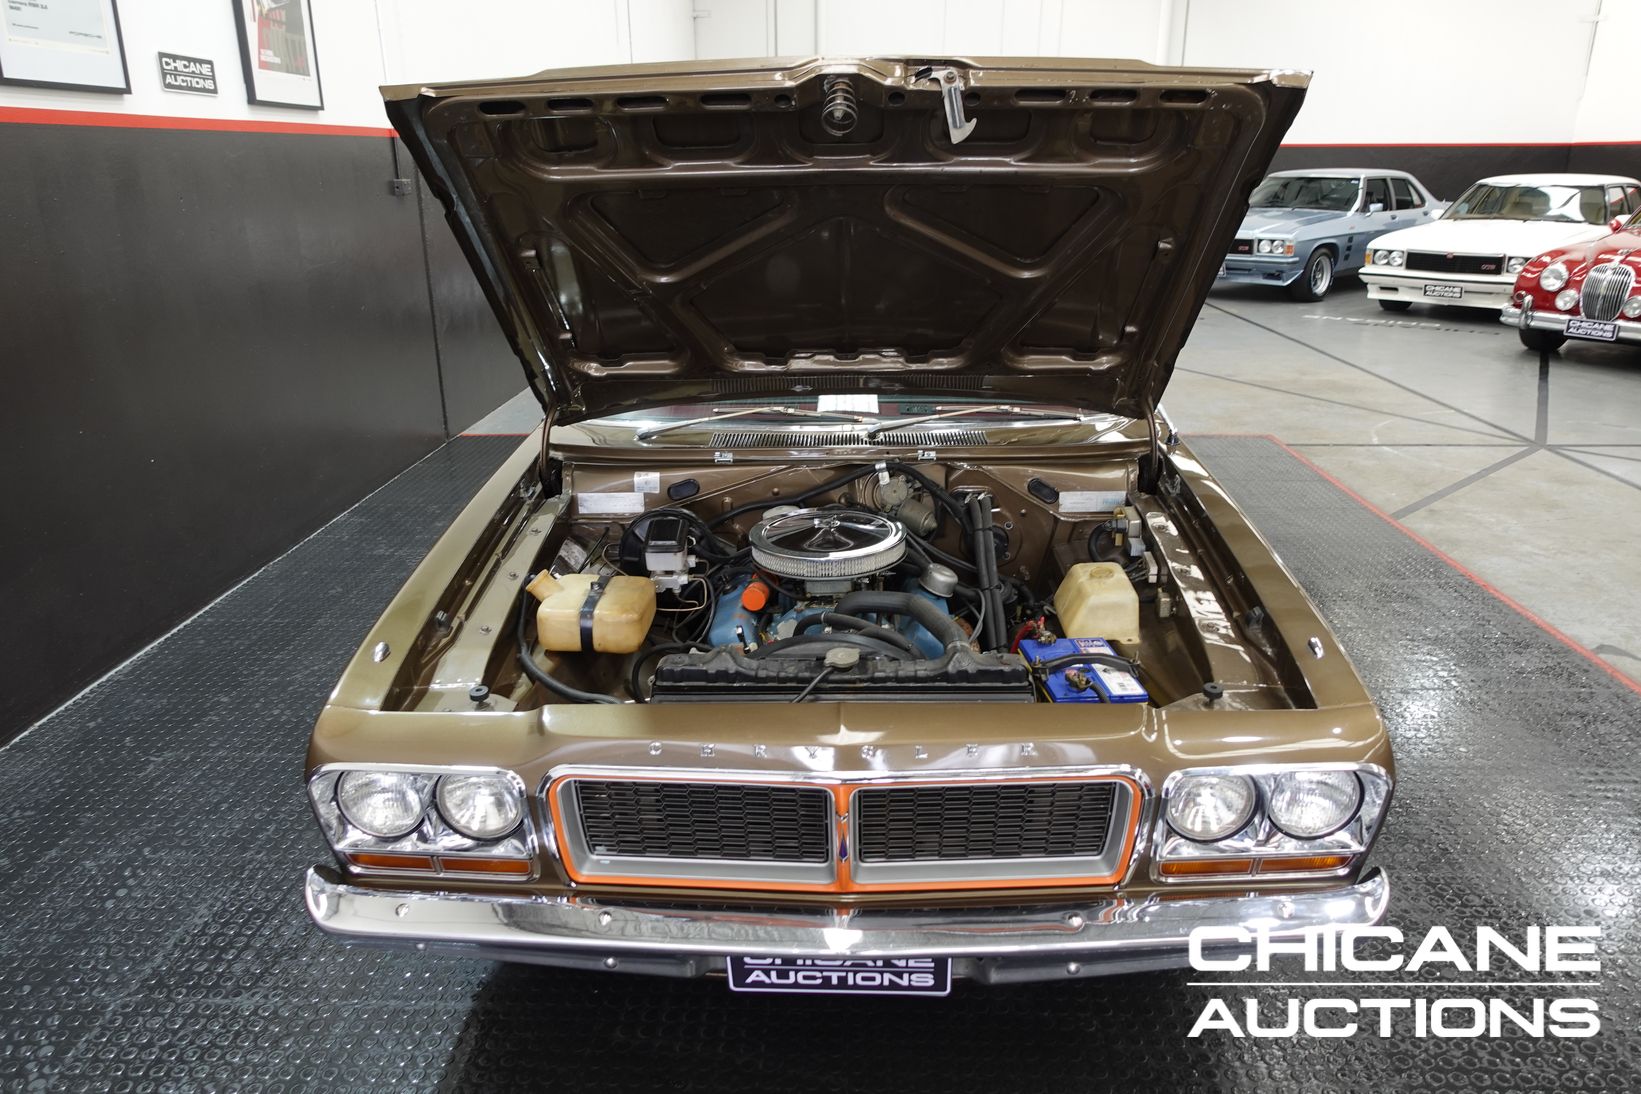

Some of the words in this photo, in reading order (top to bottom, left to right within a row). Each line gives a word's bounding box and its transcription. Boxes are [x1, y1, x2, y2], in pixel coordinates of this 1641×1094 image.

[161, 57, 213, 76] CHICANE
[165, 74, 215, 90] AUCTIONS
[1567, 327, 1613, 338] AUCTIONS
[1569, 320, 1615, 331] CHICANE
[744, 969, 936, 987] AUCTIONS
